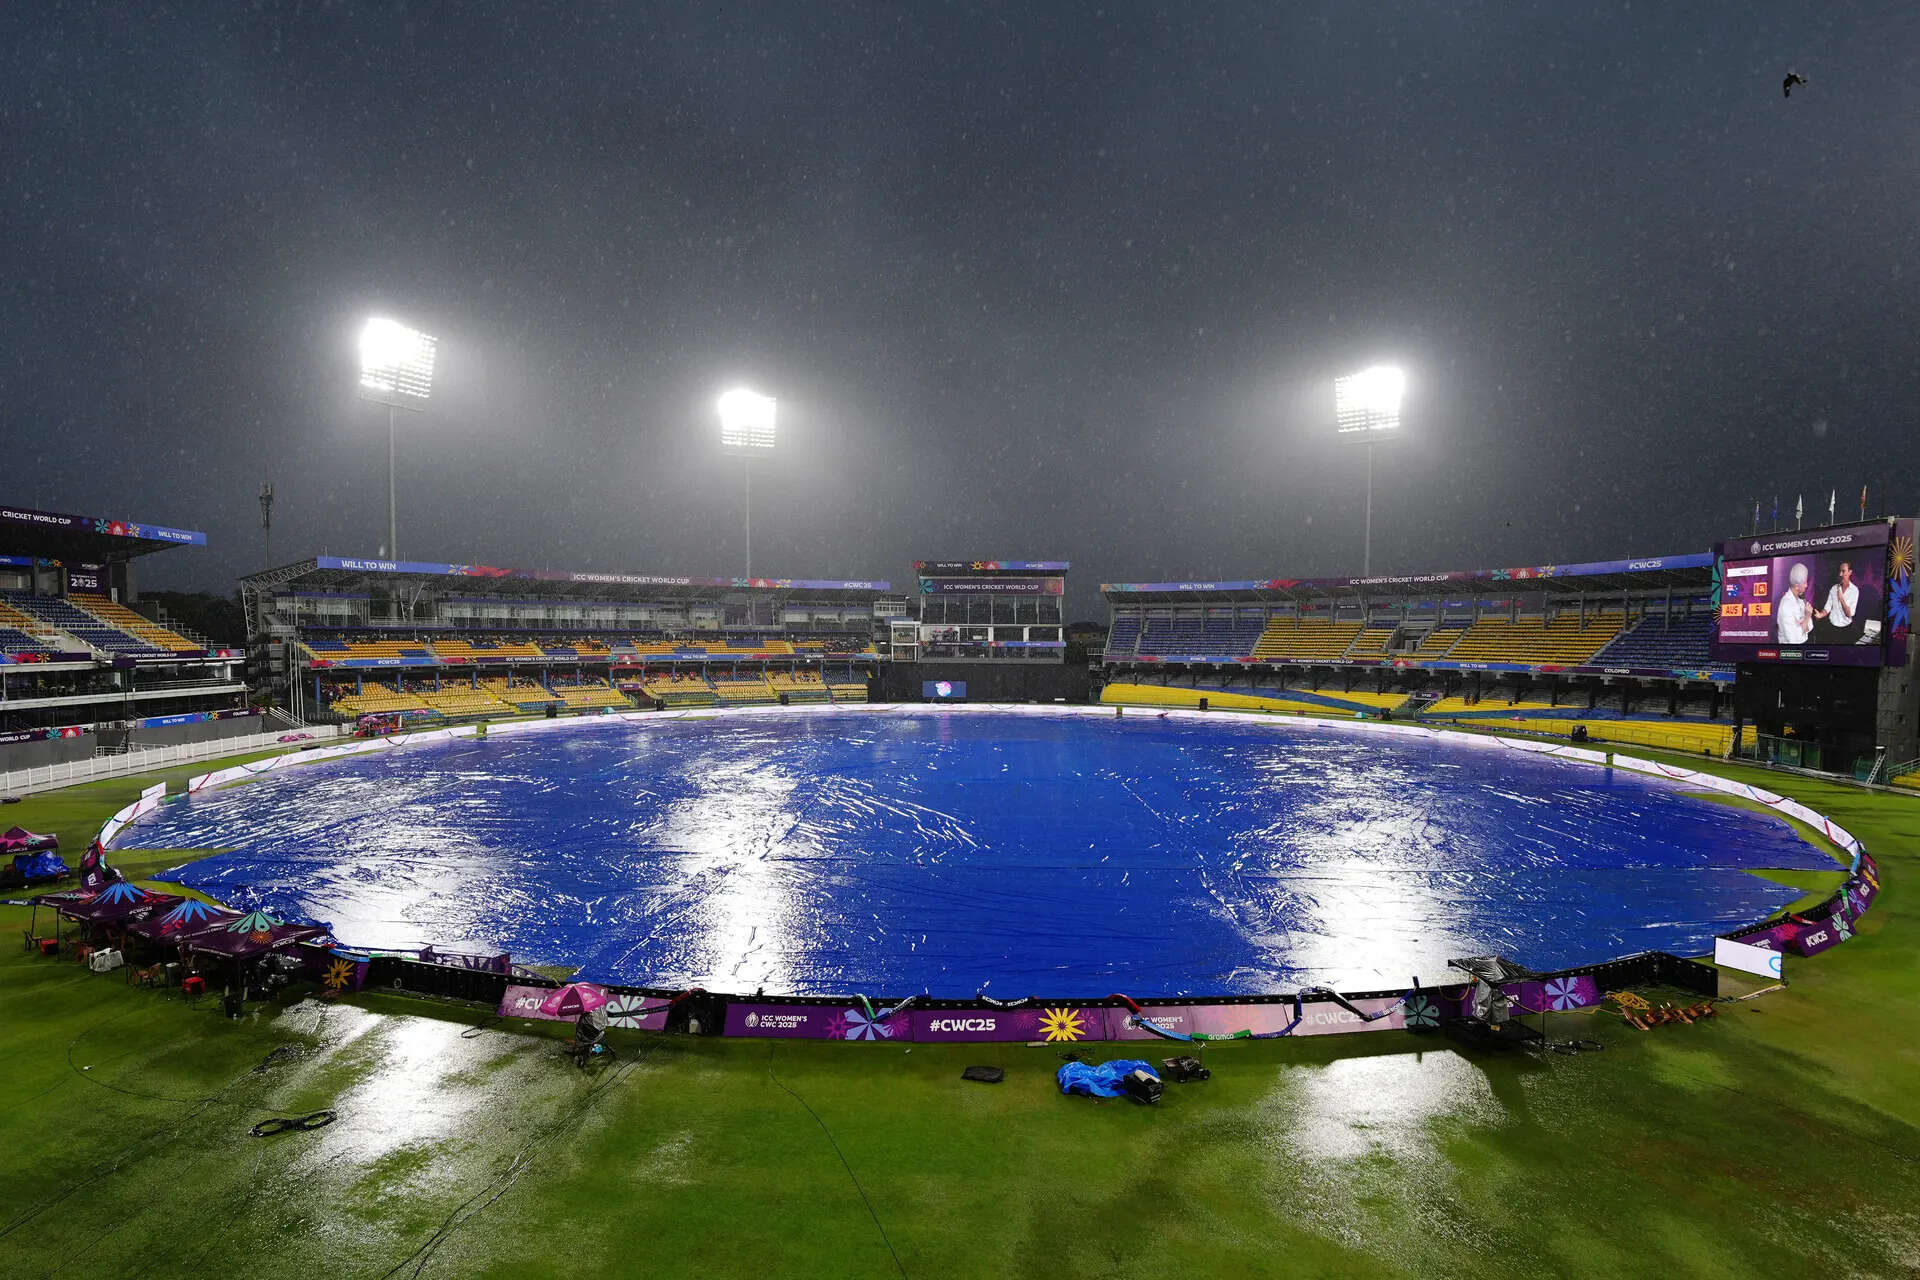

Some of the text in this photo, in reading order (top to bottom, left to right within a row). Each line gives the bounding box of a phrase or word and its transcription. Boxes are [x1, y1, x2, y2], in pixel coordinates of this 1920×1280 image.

[2, 510, 32, 520] CRICKET
[32, 514, 57, 523] WORLD
[158, 530, 171, 538] WILL
[1762, 534, 1853, 551] ICC WOMEN'S CWC 2025
[341, 559, 397, 570] WILL TO WIN
[1628, 559, 1663, 570] #CWC25
[587, 574, 621, 582] WOMEN'S
[622, 575, 650, 583] CRICKET
[1360, 577, 1388, 585] WOMEN'S
[929, 1018, 996, 1032] #CWC25
[1208, 1033, 1234, 1041] aramco
